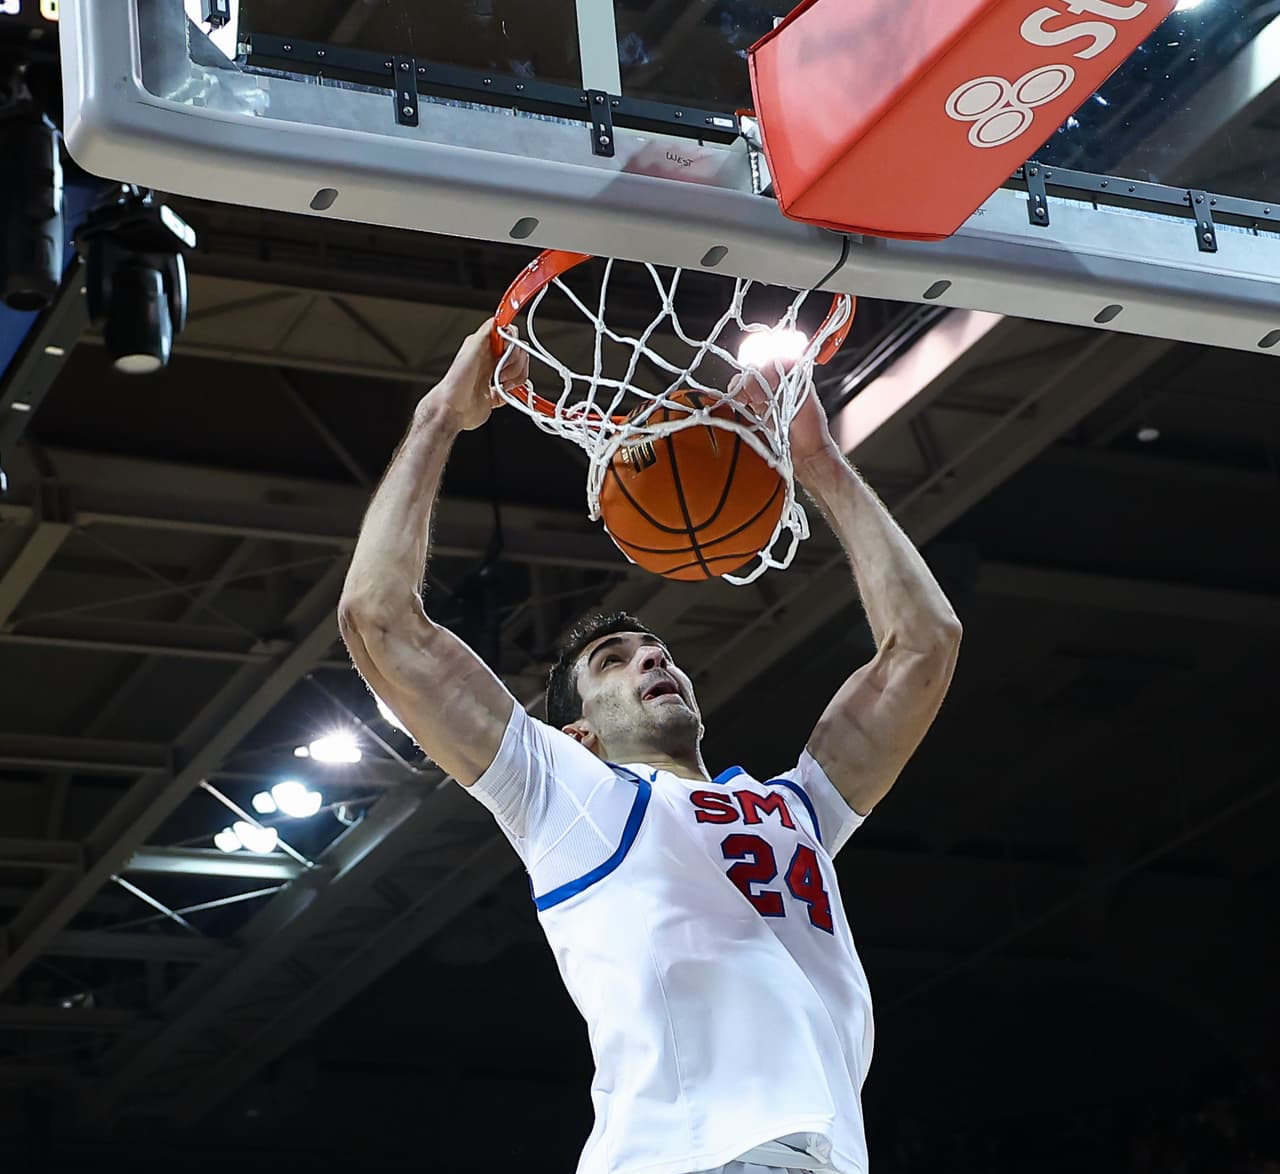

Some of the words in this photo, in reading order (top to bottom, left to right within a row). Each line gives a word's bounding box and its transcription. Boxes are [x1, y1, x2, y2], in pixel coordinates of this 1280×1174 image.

[666, 151, 695, 167] WEST
[689, 789, 797, 831] SM
[720, 833, 835, 936] 24
